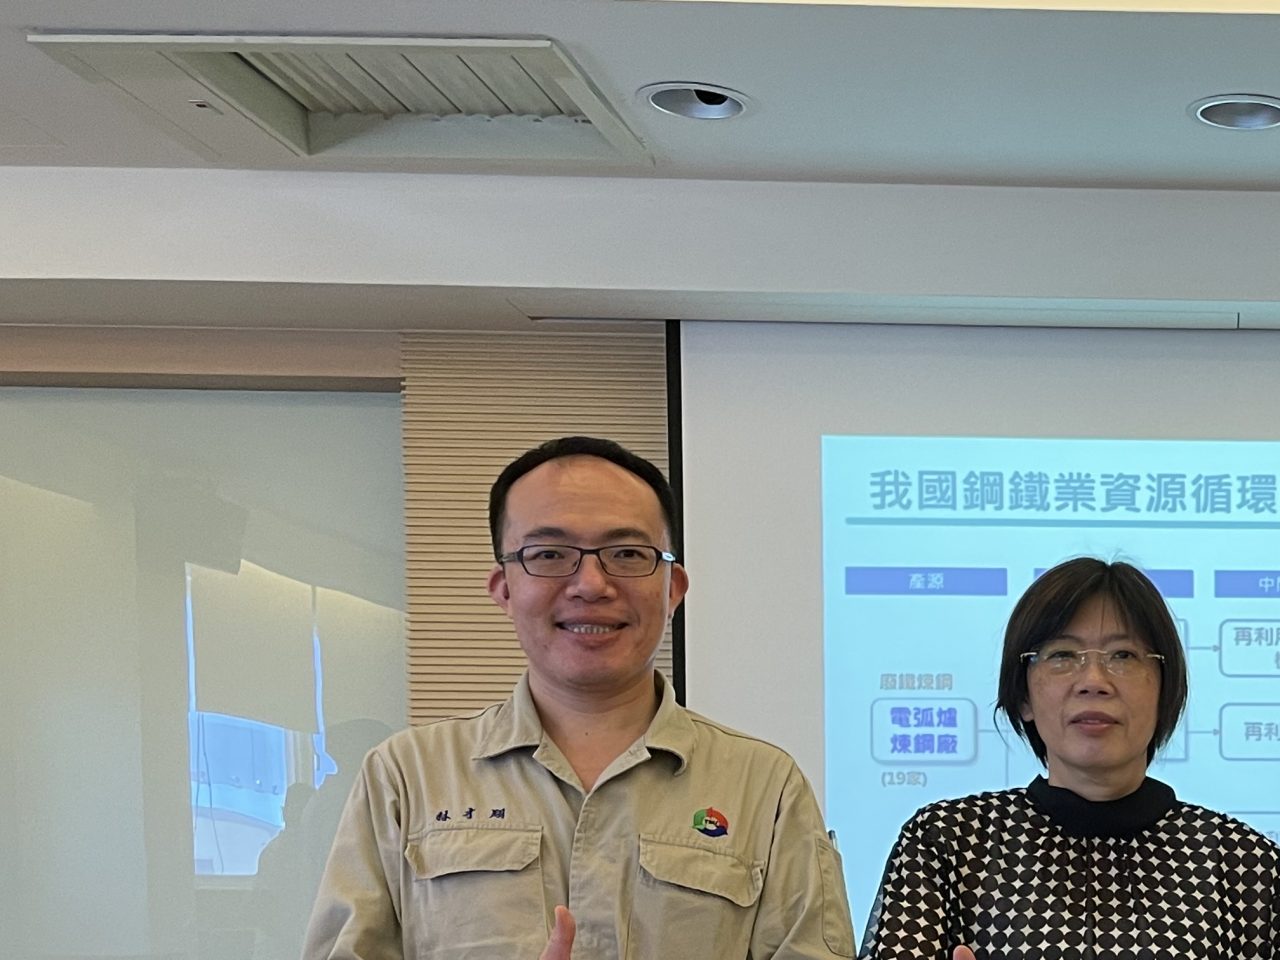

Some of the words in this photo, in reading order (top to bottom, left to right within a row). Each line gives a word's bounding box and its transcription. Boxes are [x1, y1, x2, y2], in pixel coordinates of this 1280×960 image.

[908, 572, 945, 589] 產源
[890, 707, 958, 728] 電弧爐
[890, 734, 958, 754] 煉鋼廠
